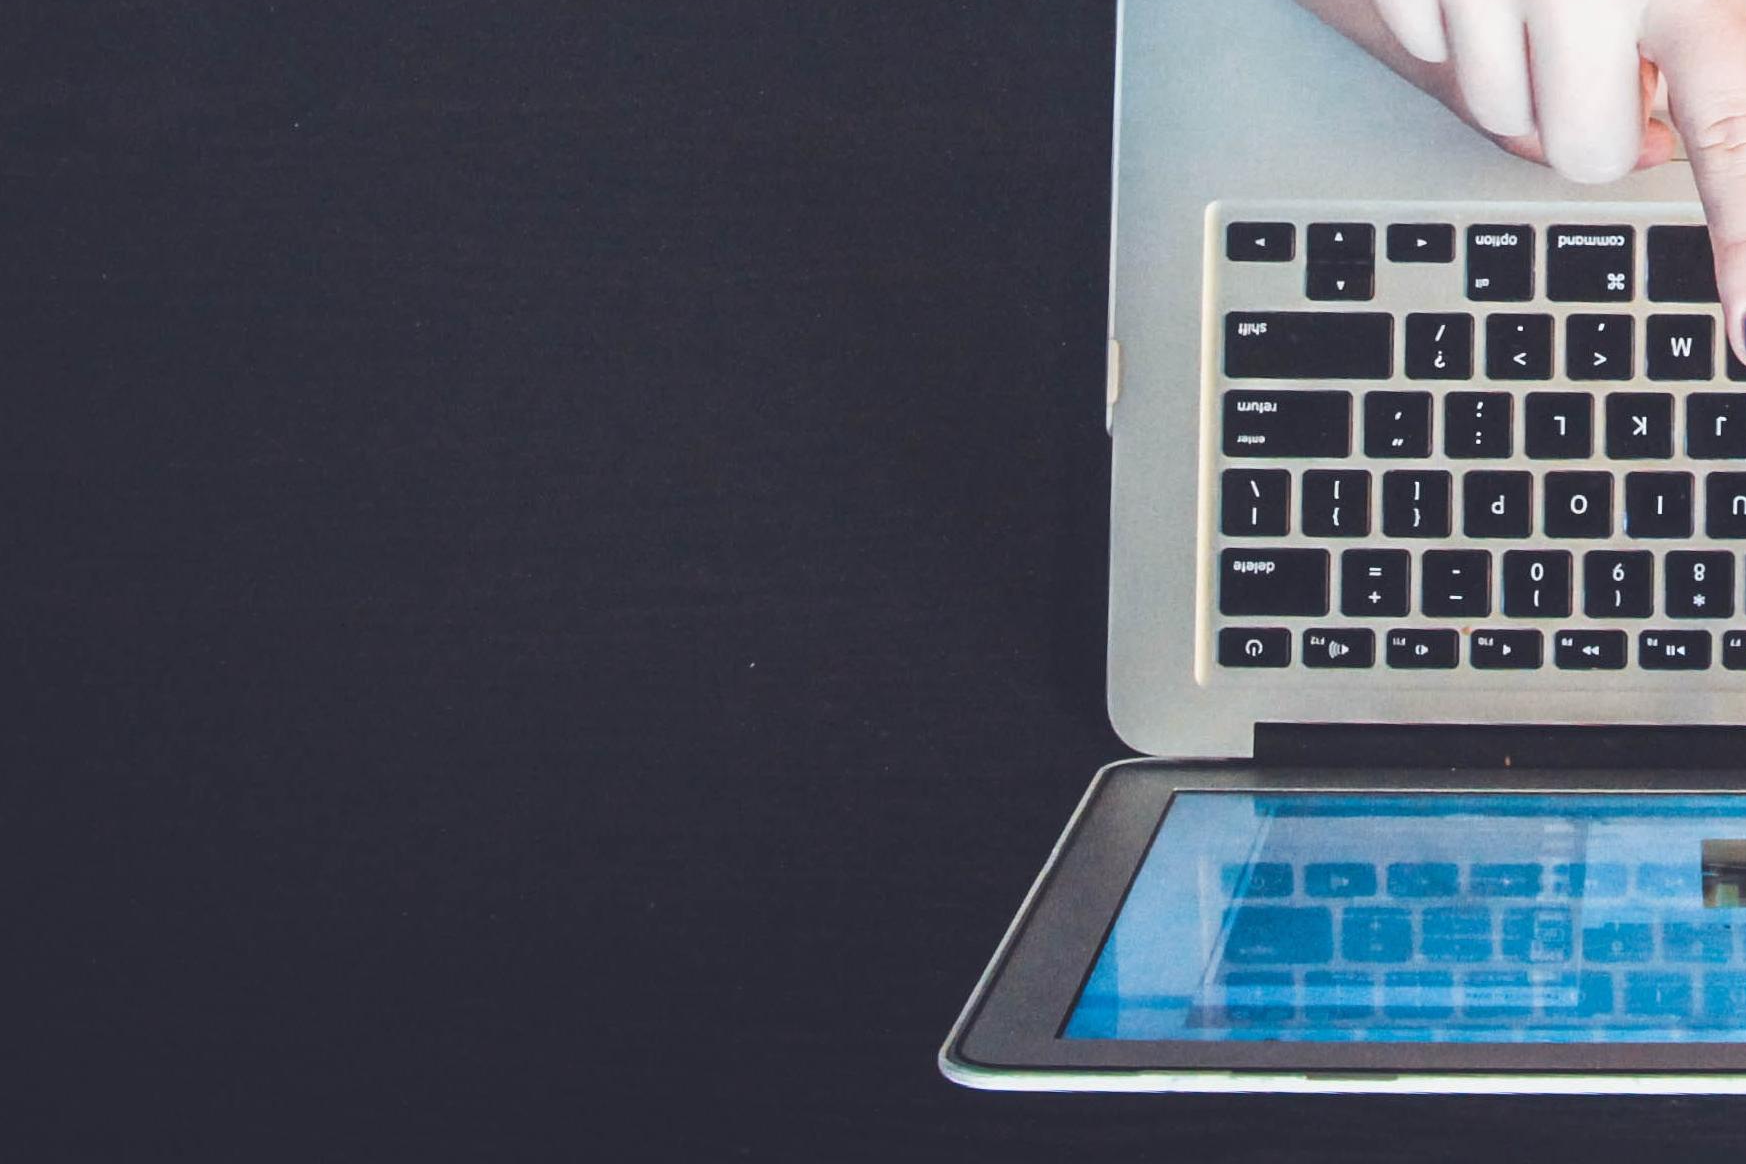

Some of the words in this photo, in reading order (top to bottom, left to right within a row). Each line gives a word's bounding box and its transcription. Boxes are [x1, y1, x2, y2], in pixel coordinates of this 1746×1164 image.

[1475, 232, 1518, 247] option
[1557, 235, 1625, 249] command
[1237, 322, 1268, 337] shift
[1670, 337, 1693, 357] M
[1434, 350, 1446, 369] ?
[1513, 352, 1527, 366] >
[1593, 352, 1607, 366] <
[1237, 401, 1278, 414] return
[1553, 415, 1566, 436] L
[1631, 415, 1647, 436] K
[1715, 416, 1728, 437] J
[1236, 435, 1266, 445] enter
[1333, 480, 1340, 500] ]
[1414, 481, 1420, 501] [
[1491, 494, 1505, 515] P
[1570, 494, 1588, 515] O
[1657, 495, 1663, 515] I
[1332, 507, 1340, 527] }
[1413, 507, 1421, 528] {
[1233, 560, 1276, 575] delete
[1368, 567, 1382, 577] =
[1530, 562, 1544, 582] 0
[1612, 562, 1625, 582] 9
[1693, 562, 1706, 582] 8
[1368, 590, 1382, 604] +
[1533, 589, 1540, 607] )
[1615, 589, 1621, 607] (
